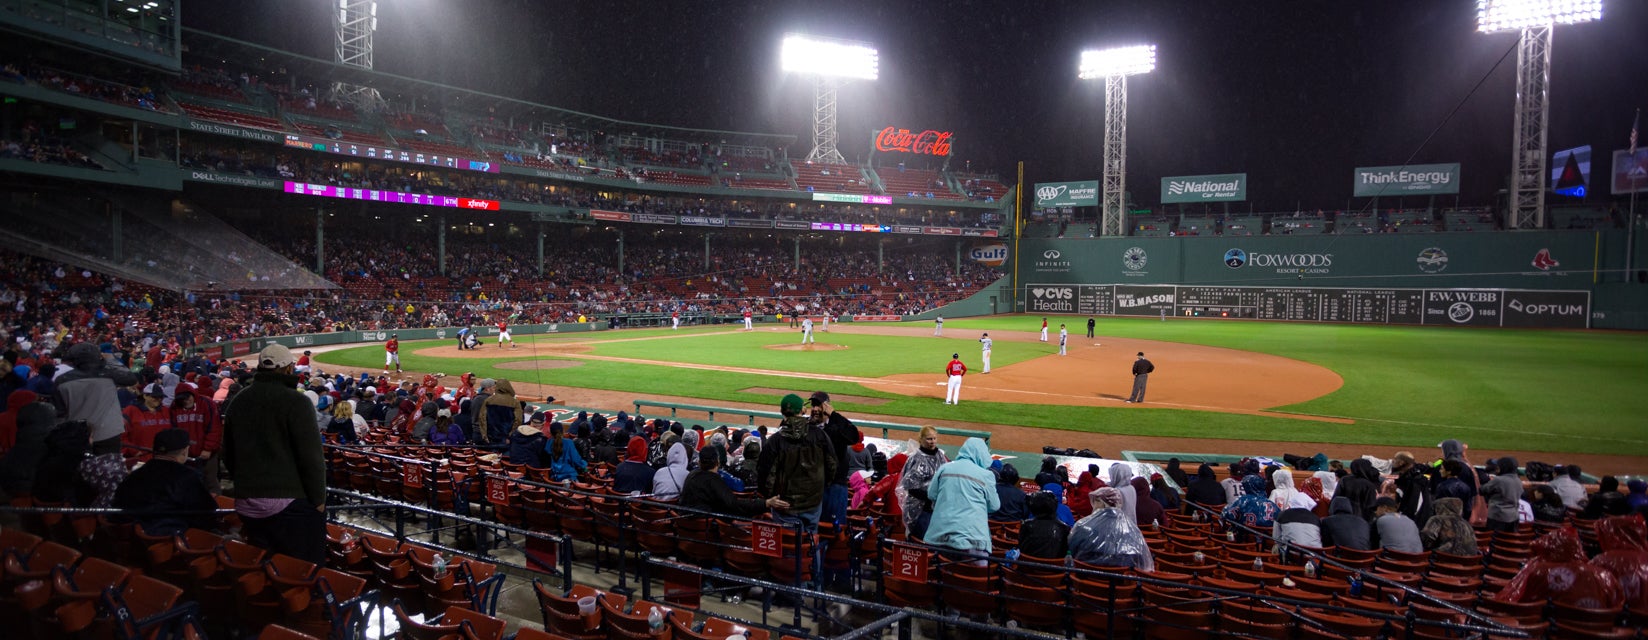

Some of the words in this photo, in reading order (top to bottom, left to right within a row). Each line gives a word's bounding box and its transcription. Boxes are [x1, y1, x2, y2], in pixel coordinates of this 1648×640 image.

[190, 121, 213, 132] STATE
[214, 125, 240, 136] STREET
[242, 129, 275, 141] PAVILION
[876, 126, 953, 155] Coca-Cola
[192, 171, 215, 181] DELL
[214, 174, 257, 186] Technologies
[1361, 171, 1450, 184] ThinkEnergy
[1184, 180, 1239, 192] National
[1039, 187, 1058, 200] AAA
[467, 199, 489, 209] xfinity
[972, 248, 1006, 259] Gulf
[1249, 252, 1332, 267] FOXWOODS
[1045, 287, 1073, 299] CVS
[1429, 292, 1454, 302] F.W.
[1456, 292, 1497, 302] WEBB
[1033, 299, 1072, 311] Health
[1526, 304, 1583, 315] OPTUM
[407, 474, 419, 484] 24
[492, 490, 505, 500] 23
[758, 525, 777, 533] FIELD
[758, 538, 777, 551] 22
[900, 547, 922, 557] FIELD
[902, 554, 919, 563] BOX
[901, 562, 918, 576] 21
